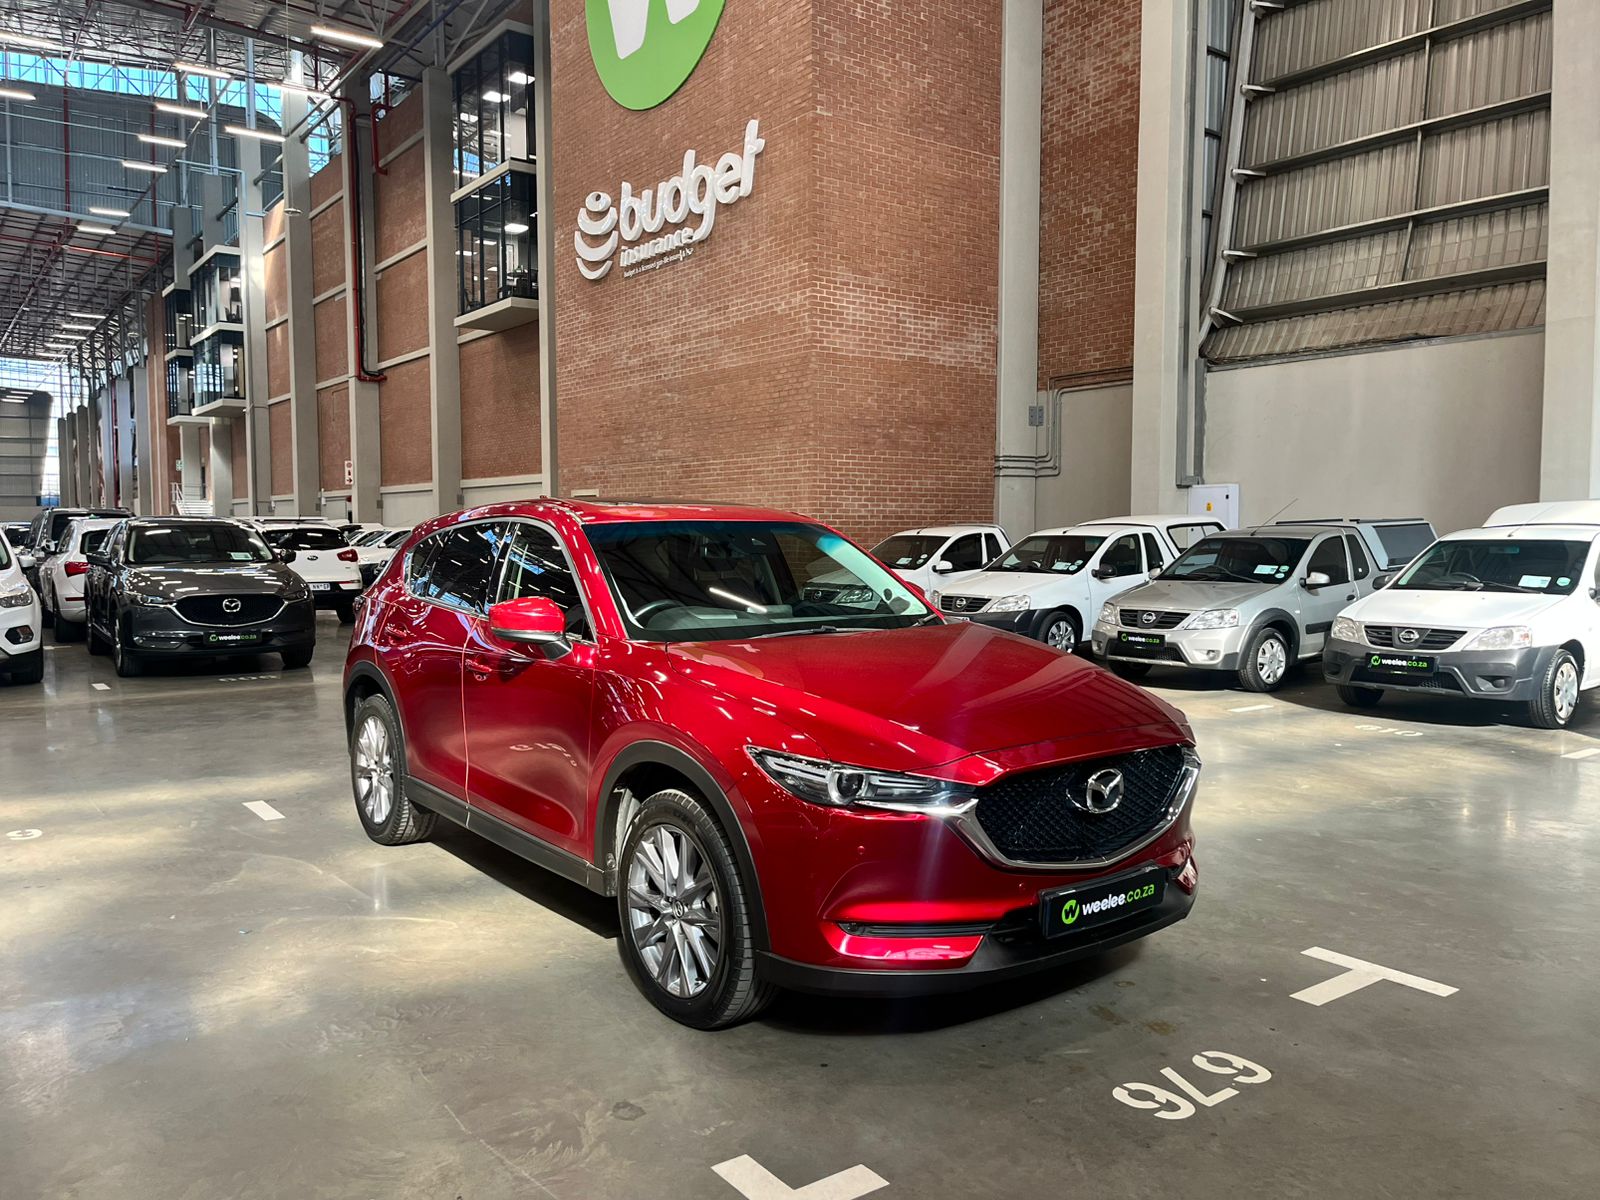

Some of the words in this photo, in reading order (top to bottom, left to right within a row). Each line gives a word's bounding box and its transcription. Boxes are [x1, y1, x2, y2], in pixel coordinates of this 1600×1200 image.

[620, 119, 766, 242] budget
[620, 227, 694, 267] insurance
[1082, 883, 1155, 916] weelee.co.za
